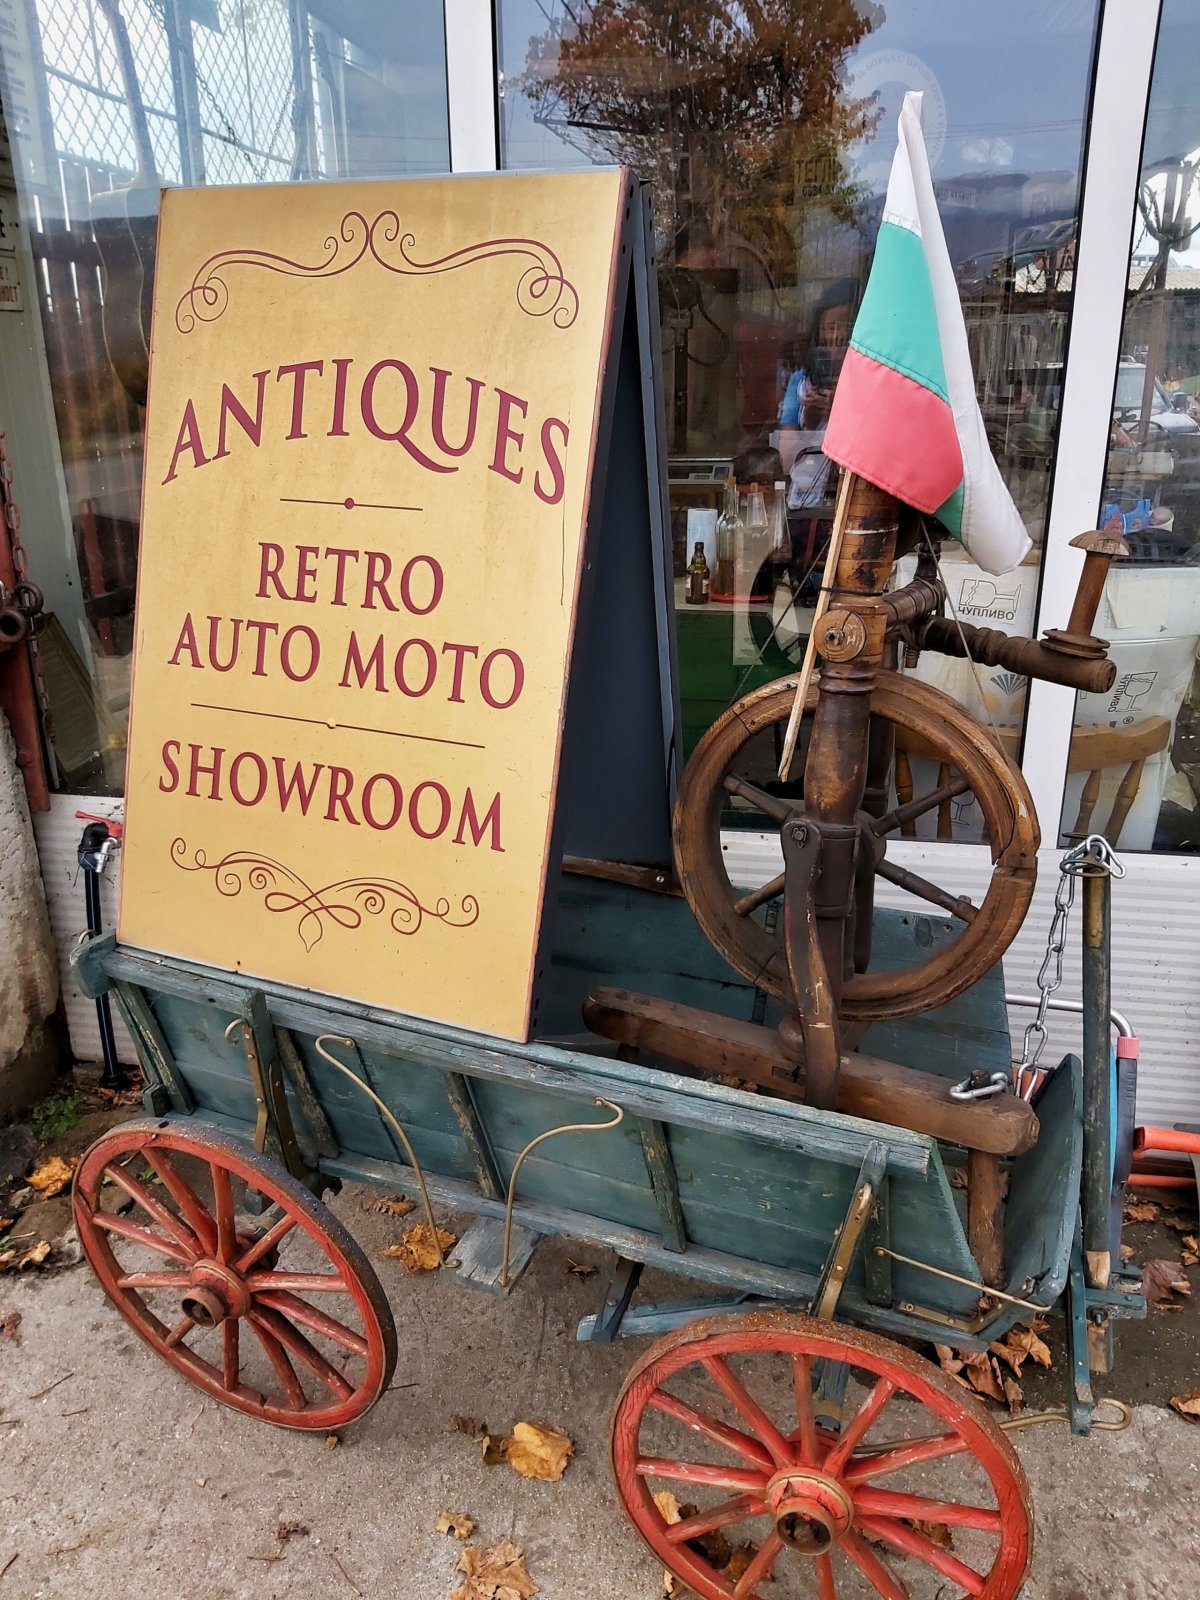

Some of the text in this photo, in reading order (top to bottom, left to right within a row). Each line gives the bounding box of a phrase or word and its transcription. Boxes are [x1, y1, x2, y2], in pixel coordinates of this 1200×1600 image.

[161, 358, 571, 506] ANTIQUES
[255, 542, 444, 616] RETRO
[957, 605, 1015, 621] ЧУПЛИВО
[168, 613, 525, 710] AUTO MOTO
[1108, 673, 1131, 713] ЧУПЛИВО
[159, 739, 506, 853] SHOWROOM
